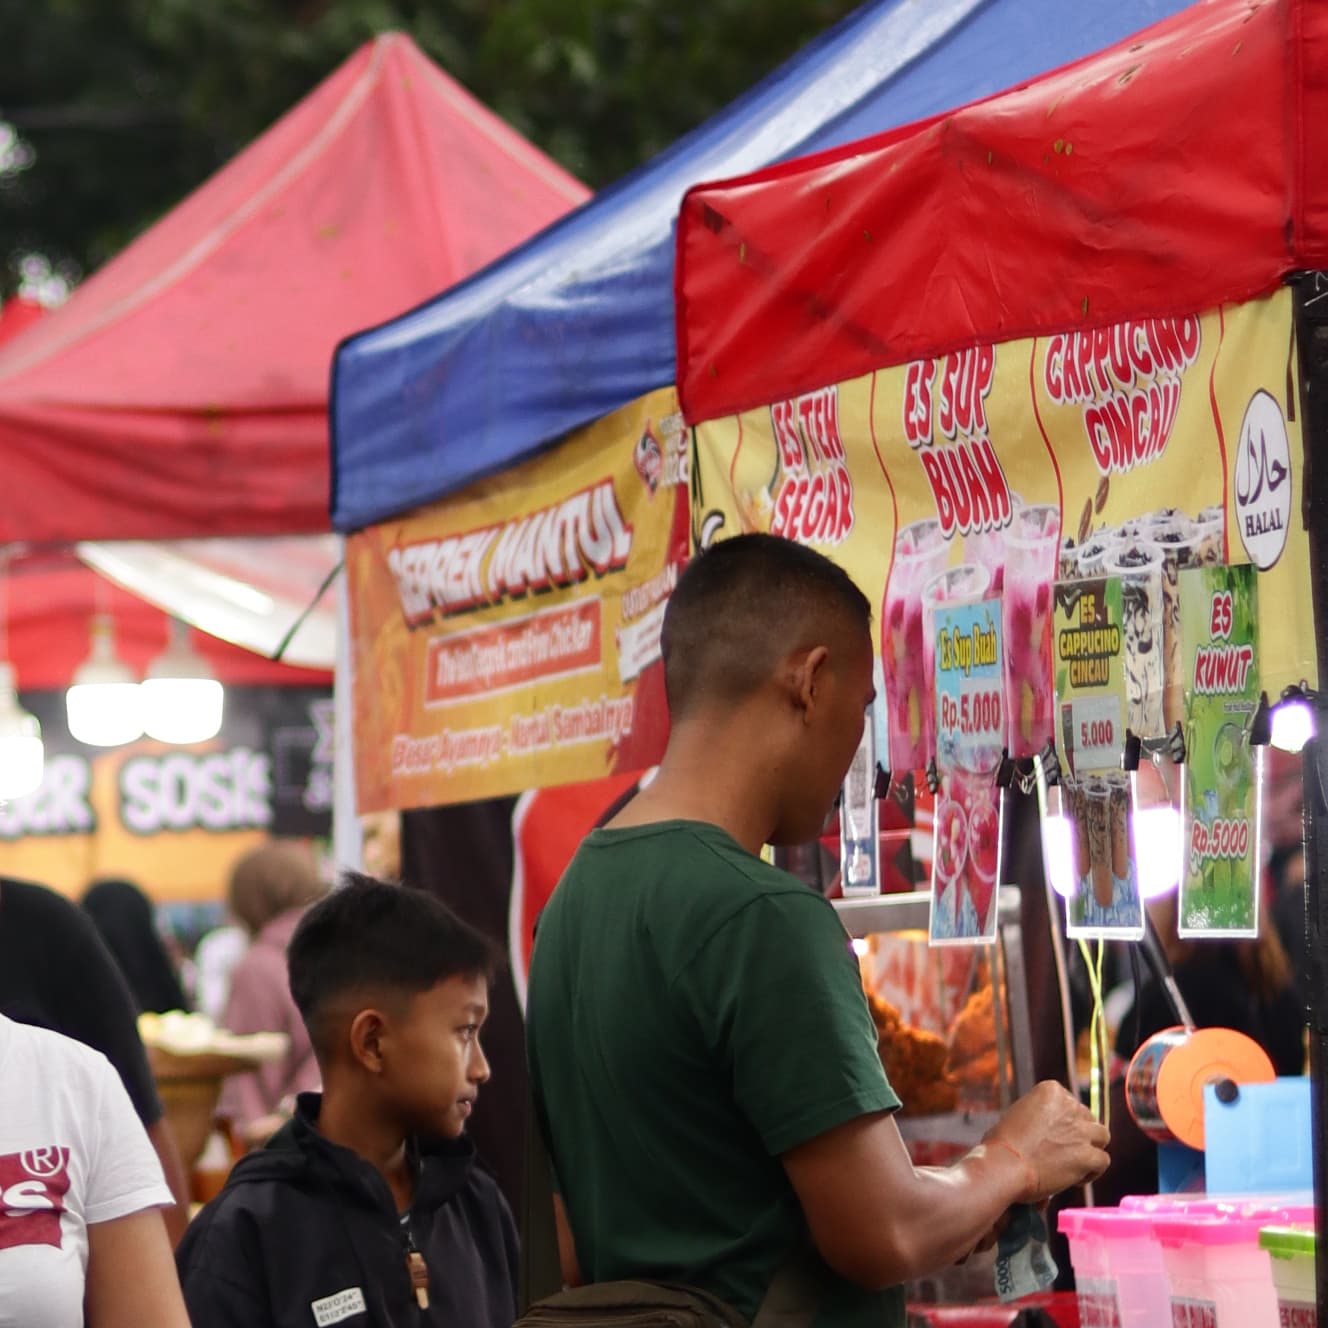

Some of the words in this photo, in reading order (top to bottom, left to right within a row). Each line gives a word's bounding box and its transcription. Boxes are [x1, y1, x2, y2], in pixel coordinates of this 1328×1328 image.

[1045, 313, 1201, 405] CAPPUCINO
[904, 359, 937, 446] ES
[939, 343, 995, 439] SUP
[772, 399, 805, 469] ES
[798, 385, 845, 463] TEH
[1084, 376, 1181, 475] CINCAU
[771, 465, 854, 544] SEGAR
[920, 435, 1012, 538] BUAH
[488, 480, 633, 598] MANTUL
[1245, 508, 1283, 538] HALAL
[1080, 594, 1095, 622] ES
[1209, 591, 1232, 641] ES
[940, 629, 952, 670] Es
[953, 626, 972, 677] Sup
[973, 621, 997, 665] Buah
[1060, 626, 1119, 659] CAPPUCINO
[1071, 658, 1109, 686] CINCAU
[1194, 645, 1253, 695] KUWUT
[1081, 720, 1113, 748] 5.000
[1191, 819, 1248, 861] Rp.5000
